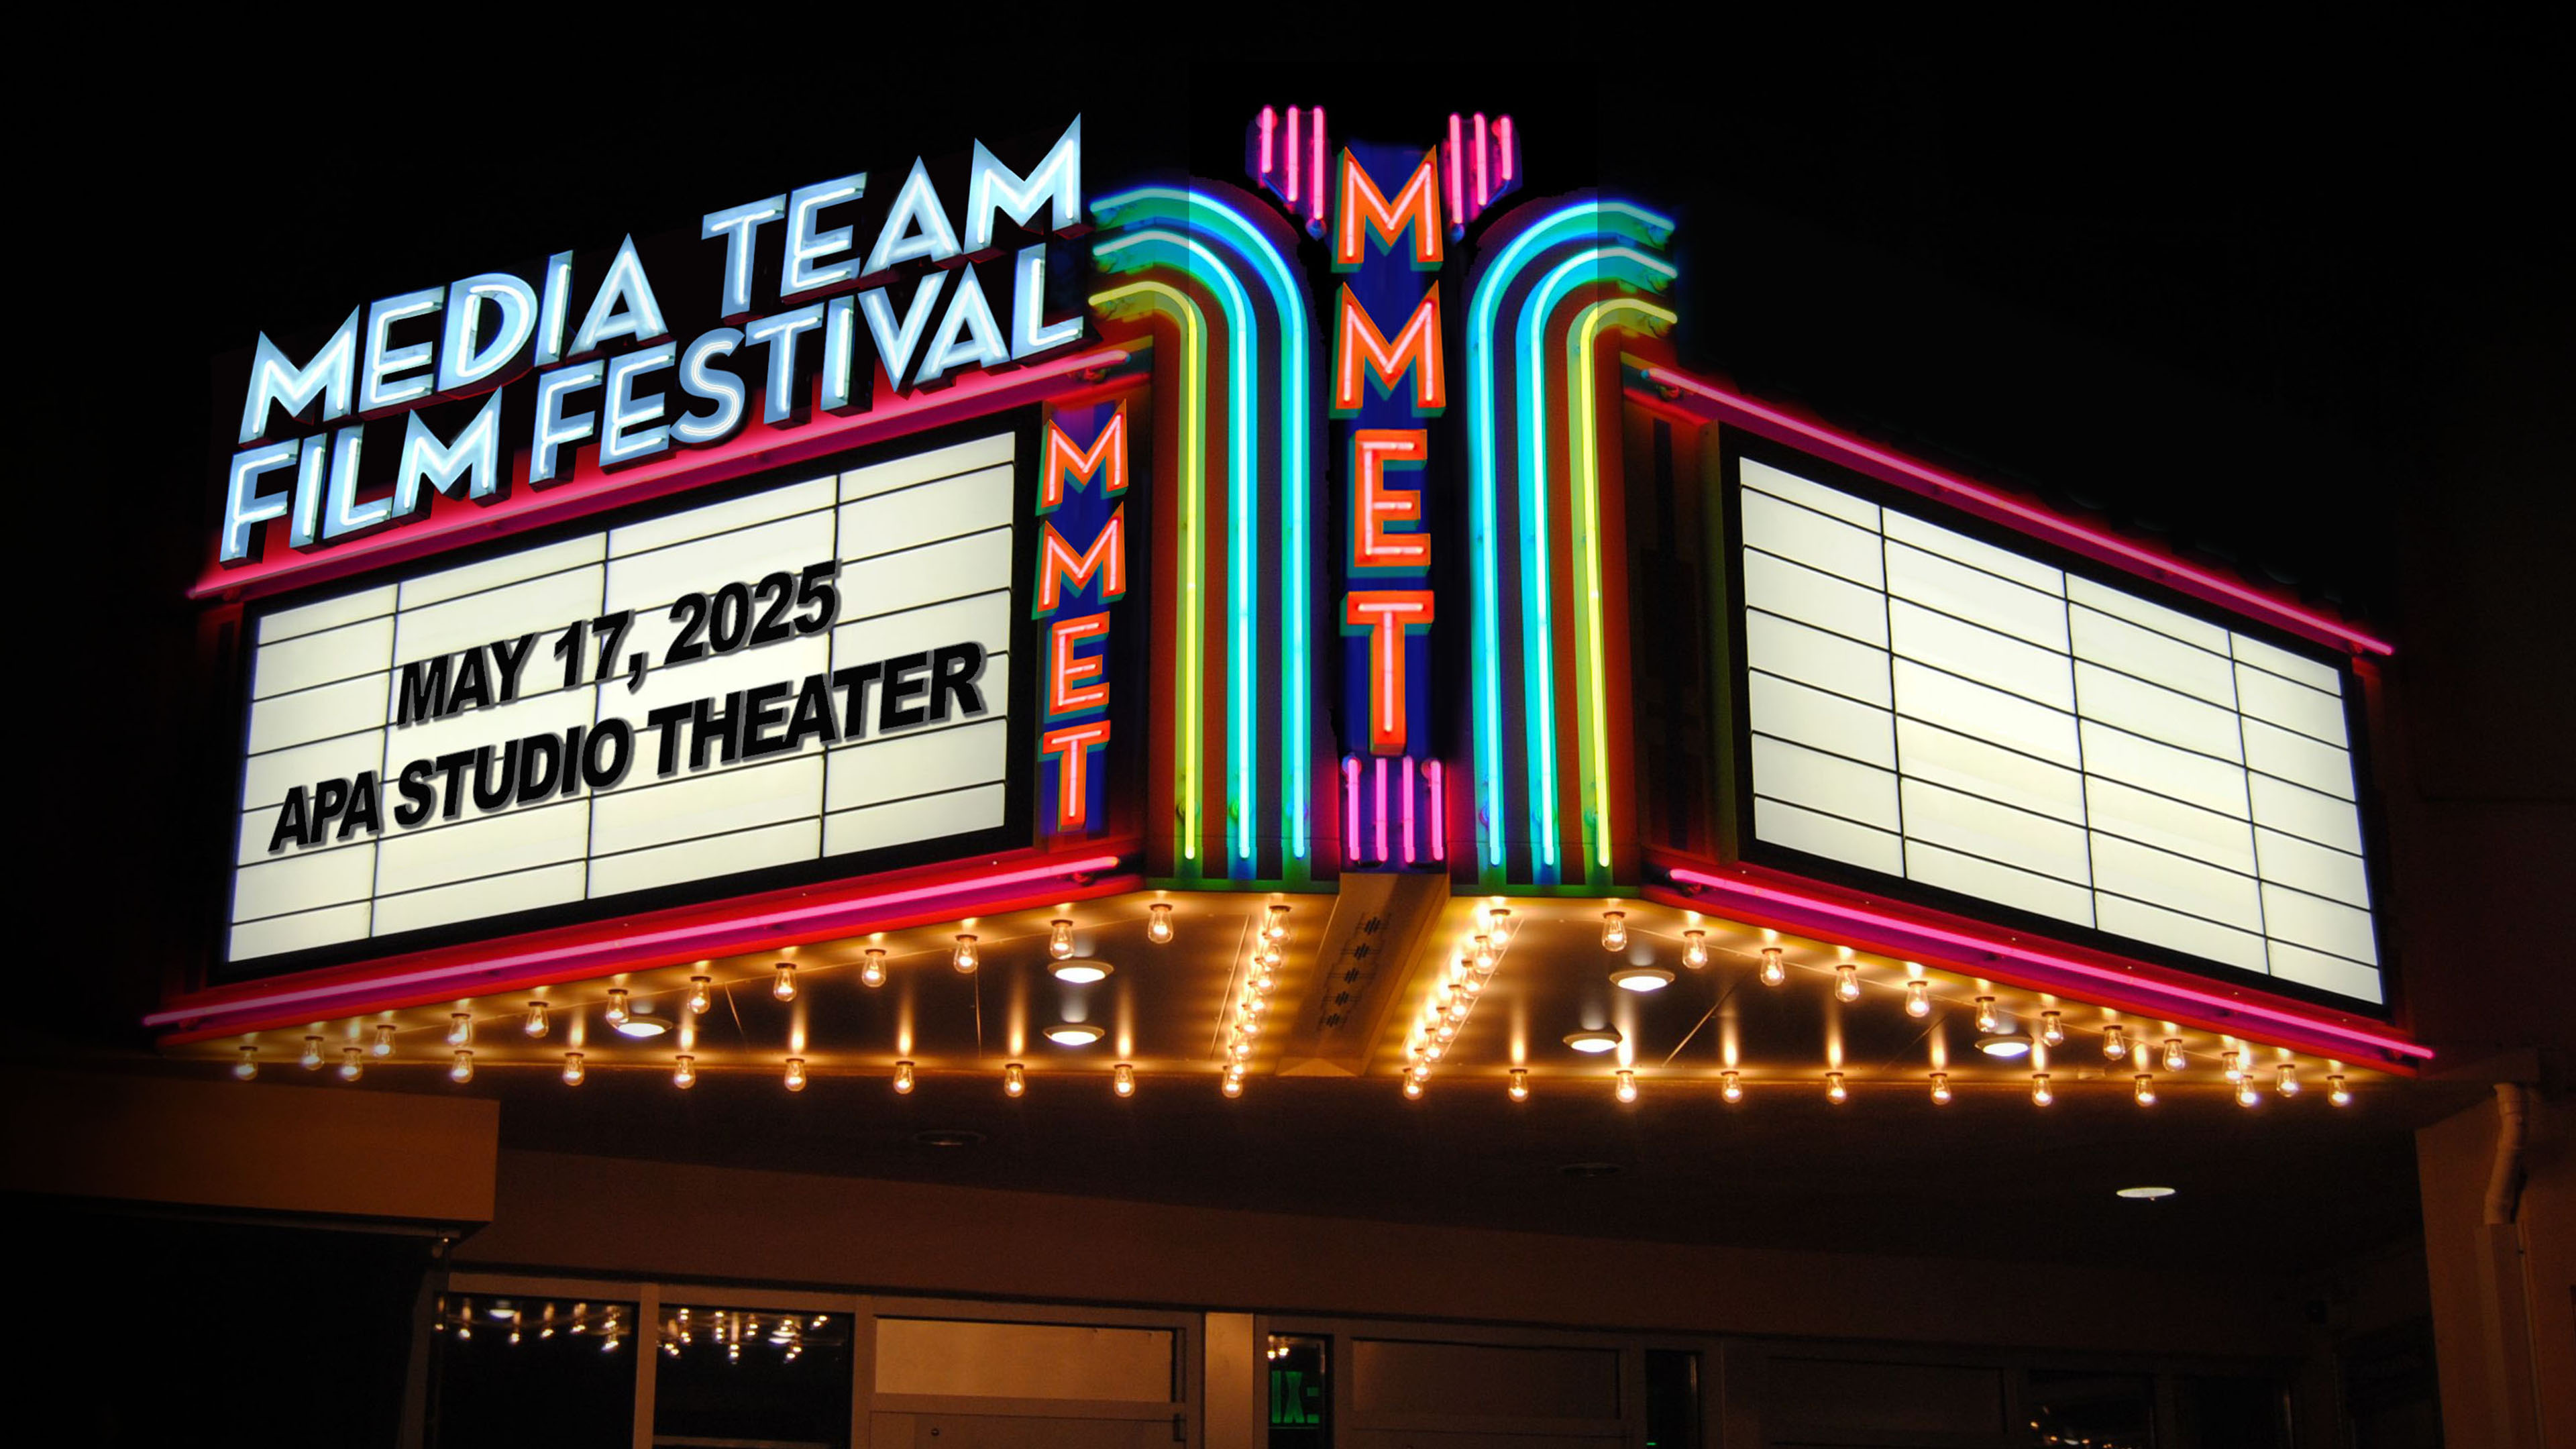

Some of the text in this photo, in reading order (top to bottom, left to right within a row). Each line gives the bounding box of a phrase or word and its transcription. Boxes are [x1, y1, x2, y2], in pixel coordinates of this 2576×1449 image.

[219, 242, 1083, 564] FILM FESTIVAL
[239, 112, 1081, 444] MEDIA TEAM
[267, 641, 988, 853] APA STUDIO THEATER
[396, 559, 842, 729] MAY 17, 2025
